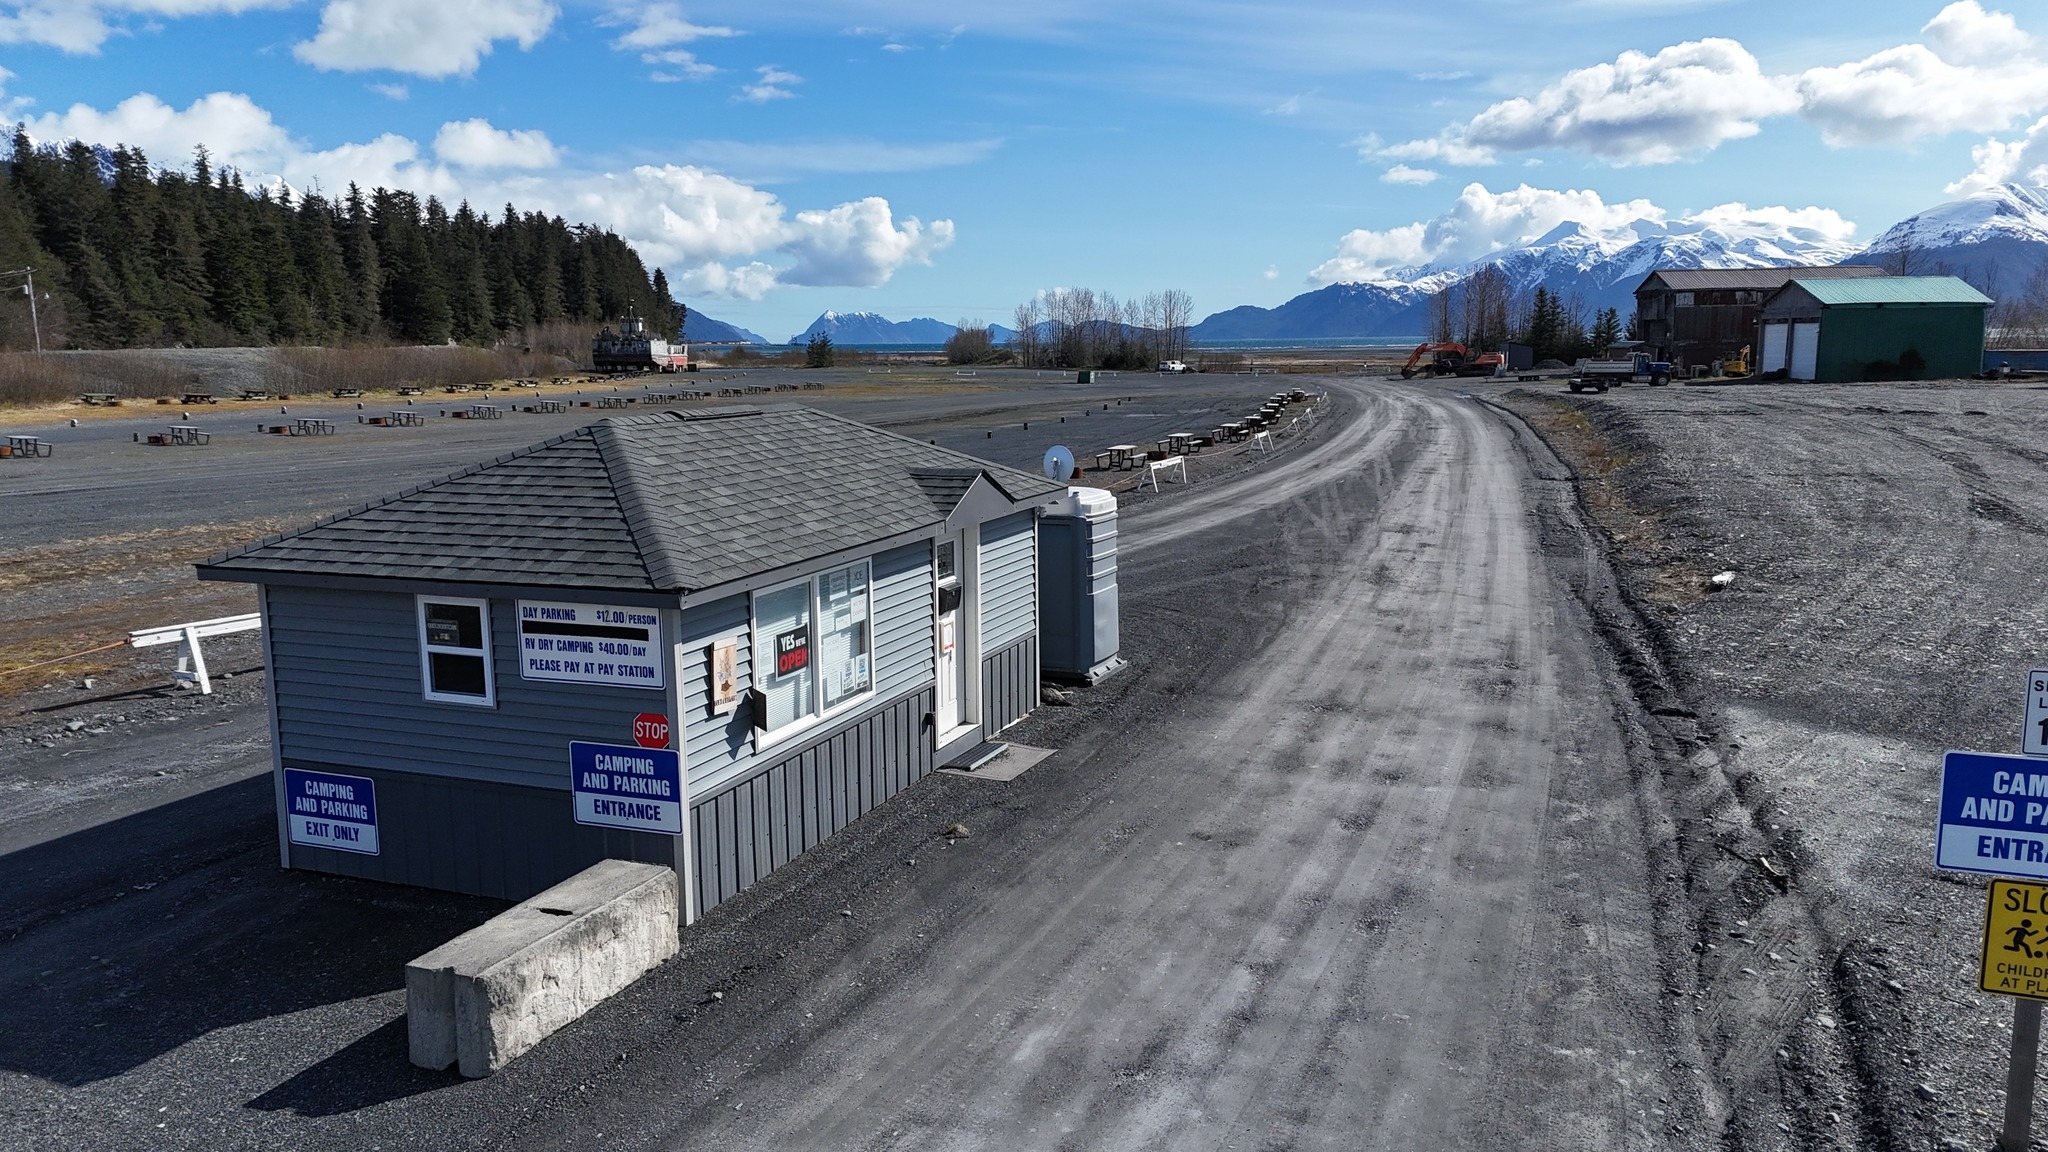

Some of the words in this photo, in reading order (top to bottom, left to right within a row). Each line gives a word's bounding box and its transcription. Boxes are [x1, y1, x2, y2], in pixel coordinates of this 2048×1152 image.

[523, 606, 538, 619] DAY
[541, 608, 576, 621] PARKING
[525, 638, 535, 650] RV
[538, 639, 553, 651] DRY
[557, 640, 594, 653] CAMPING
[598, 642, 646, 657] $40.00/DAY
[781, 634, 795, 652] YES
[529, 658, 561, 672] PLEASE
[564, 661, 580, 673] PAY
[584, 662, 595, 674] AT
[599, 663, 614, 676] PAY
[618, 665, 655, 679] STATION
[779, 646, 808, 672] OPEN
[2034, 680, 2048, 692] S
[635, 721, 669, 740] STOP
[595, 754, 655, 775] CAMPING
[305, 780, 354, 801] CAMPING
[582, 772, 609, 790] AND
[613, 775, 671, 797] PARKING
[295, 796, 318, 813] AND
[321, 800, 368, 820] PARKING
[593, 799, 662, 822] ENTRANCE
[1960, 796, 2015, 822] AND
[305, 821, 329, 838] EXIT
[333, 825, 360, 842] ONLY
[1976, 835, 2048, 866] ENTR
[2000, 977, 2020, 989] AT
